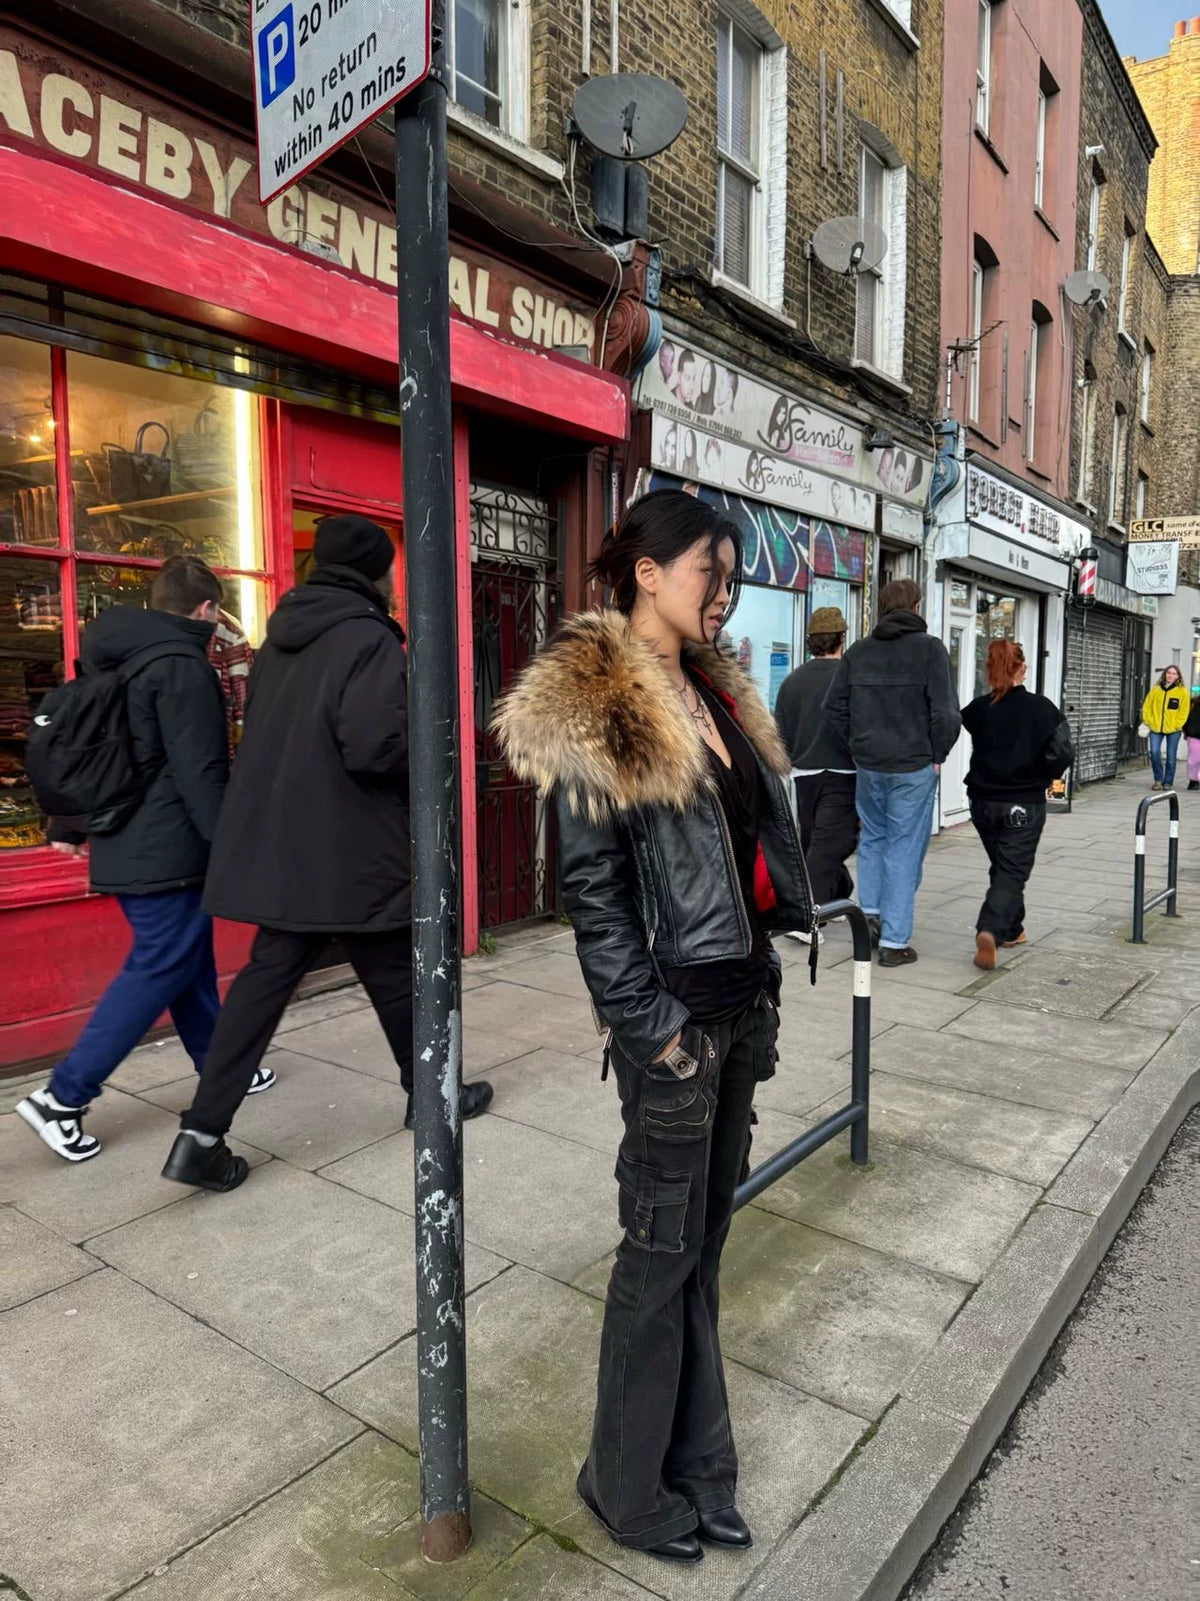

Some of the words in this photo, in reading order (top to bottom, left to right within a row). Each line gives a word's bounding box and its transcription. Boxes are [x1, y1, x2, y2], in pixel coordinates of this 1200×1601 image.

[299, 2, 321, 47] 20
[267, 21, 289, 95] P
[293, 87, 315, 122] No
[321, 32, 377, 97] return
[274, 123, 322, 178] within
[328, 91, 353, 131] 40
[361, 56, 406, 110] mins
[267, 185, 500, 328] GENEAL
[510, 286, 595, 350] SHOP
[757, 403, 855, 458] Family
[738, 456, 813, 496] Family
[1131, 531, 1159, 540] MONEY
[1132, 520, 1162, 533] GLC
